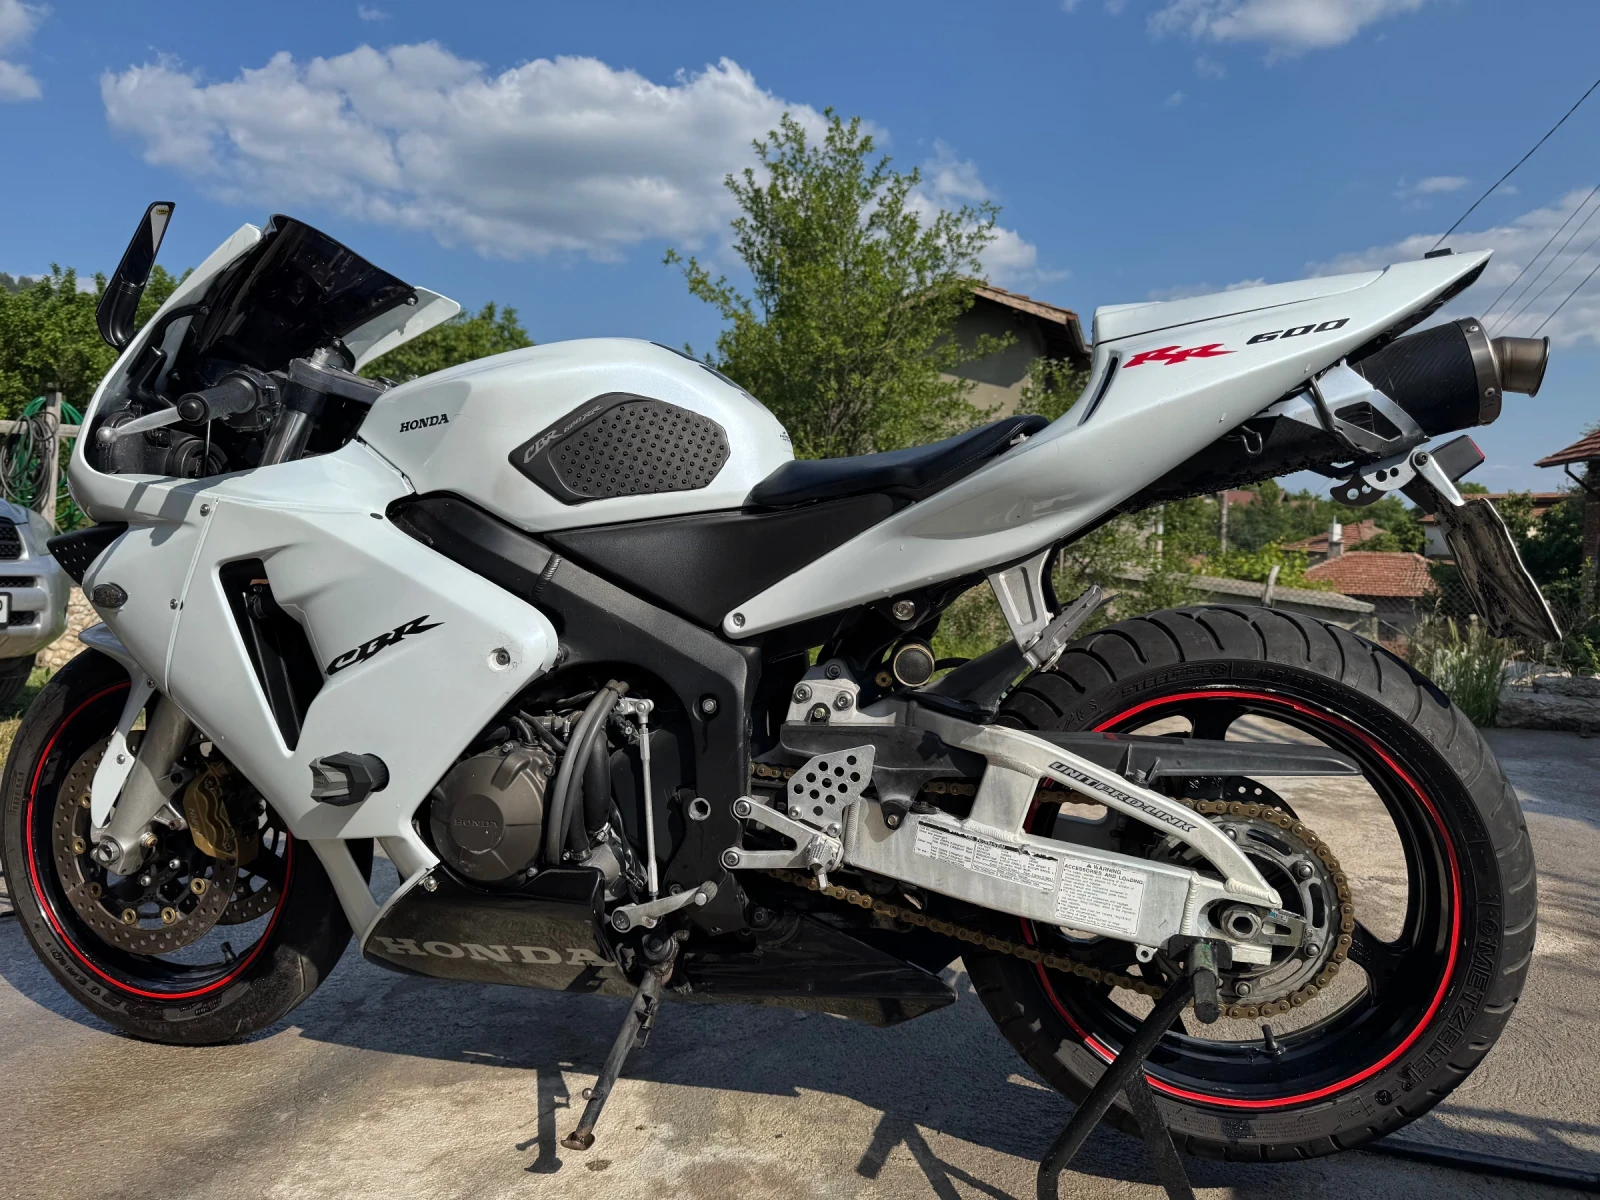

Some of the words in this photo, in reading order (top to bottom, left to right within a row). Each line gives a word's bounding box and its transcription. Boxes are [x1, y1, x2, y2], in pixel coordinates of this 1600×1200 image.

[1245, 317, 1351, 345] 600
[399, 413, 450, 433] HONDA
[523, 428, 563, 464] CBR
[324, 614, 446, 676] CBR
[1048, 761, 1098, 787] UNIT
[453, 817, 500, 829] HONDA
[1093, 863, 1122, 875] WARNING
[374, 936, 617, 967] HONDA
